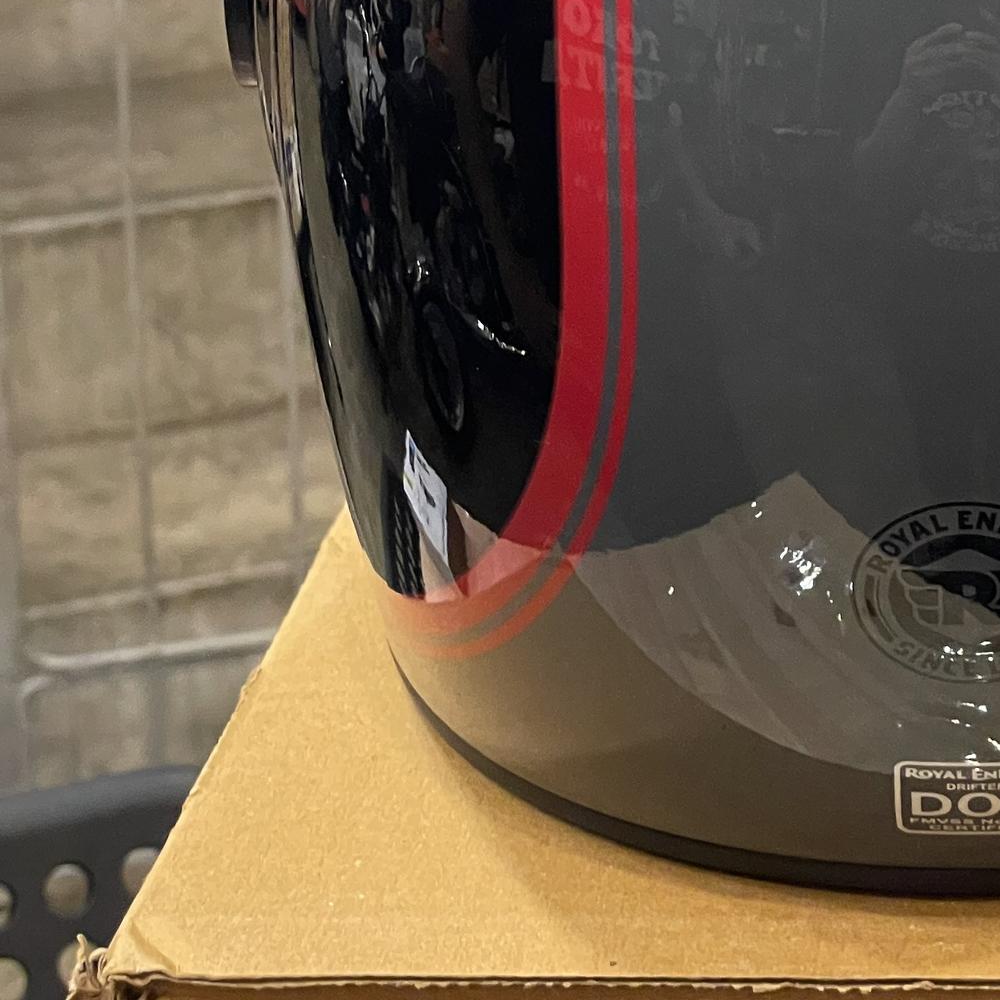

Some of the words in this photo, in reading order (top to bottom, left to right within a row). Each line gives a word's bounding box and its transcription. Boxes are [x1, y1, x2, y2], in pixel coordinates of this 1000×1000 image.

[866, 514, 949, 575] ROYAL
[895, 641, 976, 678] SINCE
[905, 767, 966, 780] ROYAL
